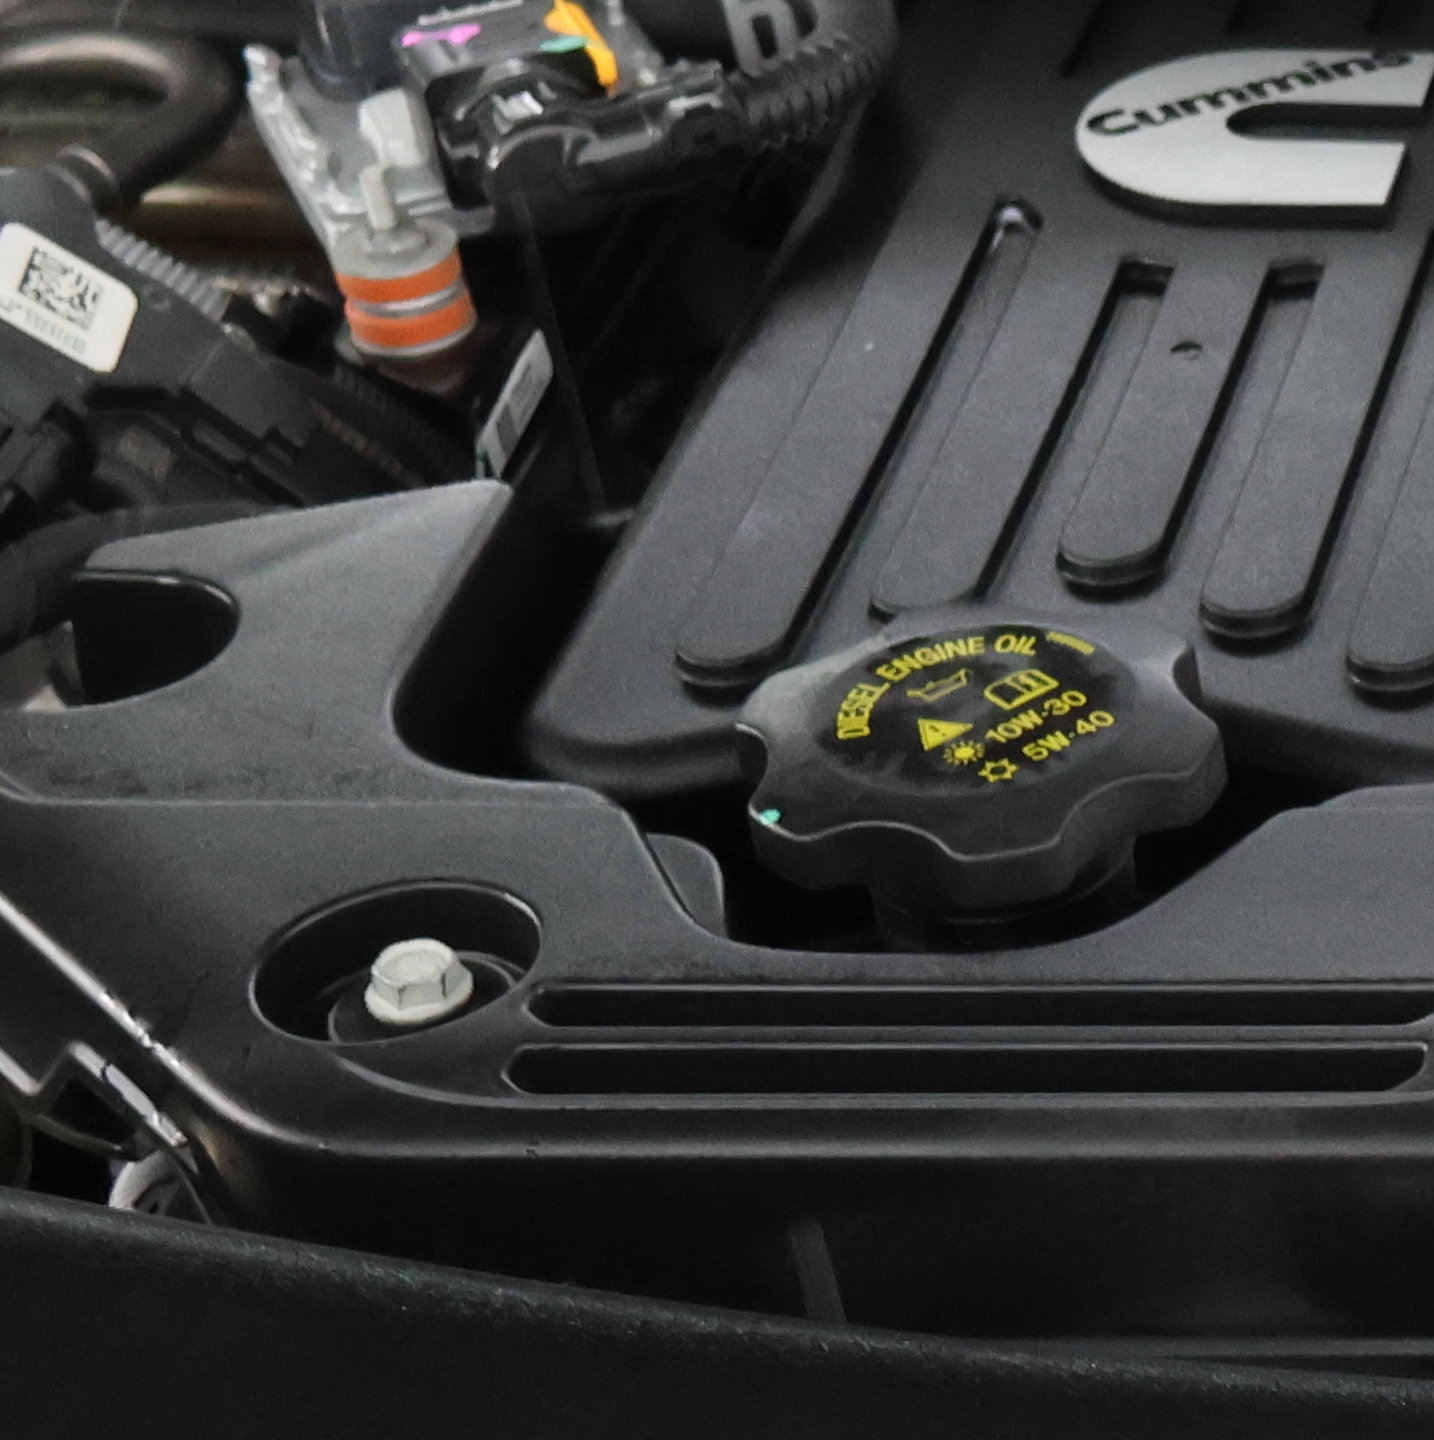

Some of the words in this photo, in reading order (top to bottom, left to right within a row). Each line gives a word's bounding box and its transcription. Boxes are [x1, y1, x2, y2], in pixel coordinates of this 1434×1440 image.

[1086, 48, 1418, 140] Cummins
[837, 682, 890, 740] DIESEL
[876, 636, 986, 682] ENGINE
[994, 632, 1037, 657] OIL
[985, 688, 1088, 747] 10W-30
[1021, 708, 1115, 763] 5W-40
